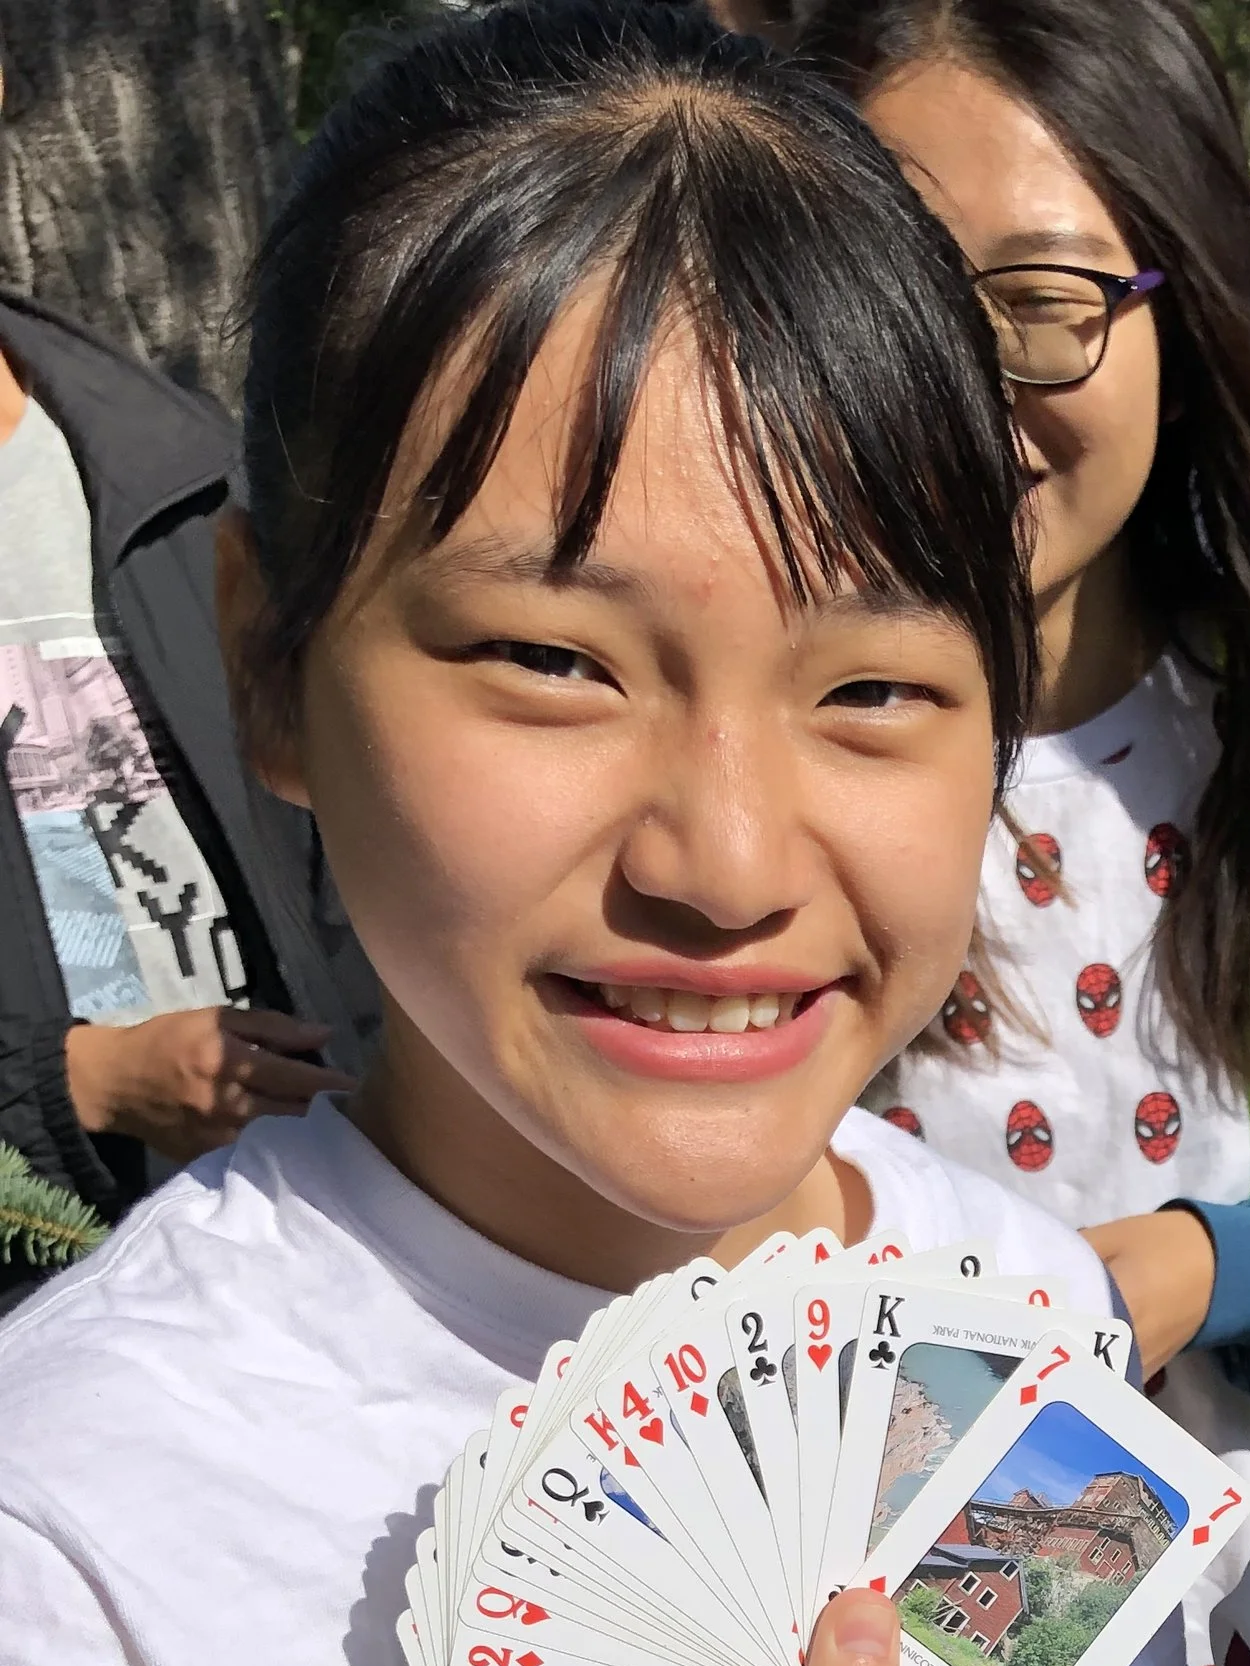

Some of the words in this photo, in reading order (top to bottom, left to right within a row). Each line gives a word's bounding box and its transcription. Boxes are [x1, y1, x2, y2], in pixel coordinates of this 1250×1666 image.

[741, 1312, 768, 1354] 2
[807, 1299, 830, 1340] 9
[873, 1295, 905, 1337] K
[932, 1324, 959, 1340] PARK
[963, 1329, 1013, 1347] NATIONAL
[1093, 1331, 1119, 1372] K
[663, 1343, 707, 1393] 10
[1037, 1345, 1070, 1380] 7
[622, 1381, 655, 1421] 4
[542, 1467, 590, 1507] Q
[1208, 1487, 1243, 1522] 7
